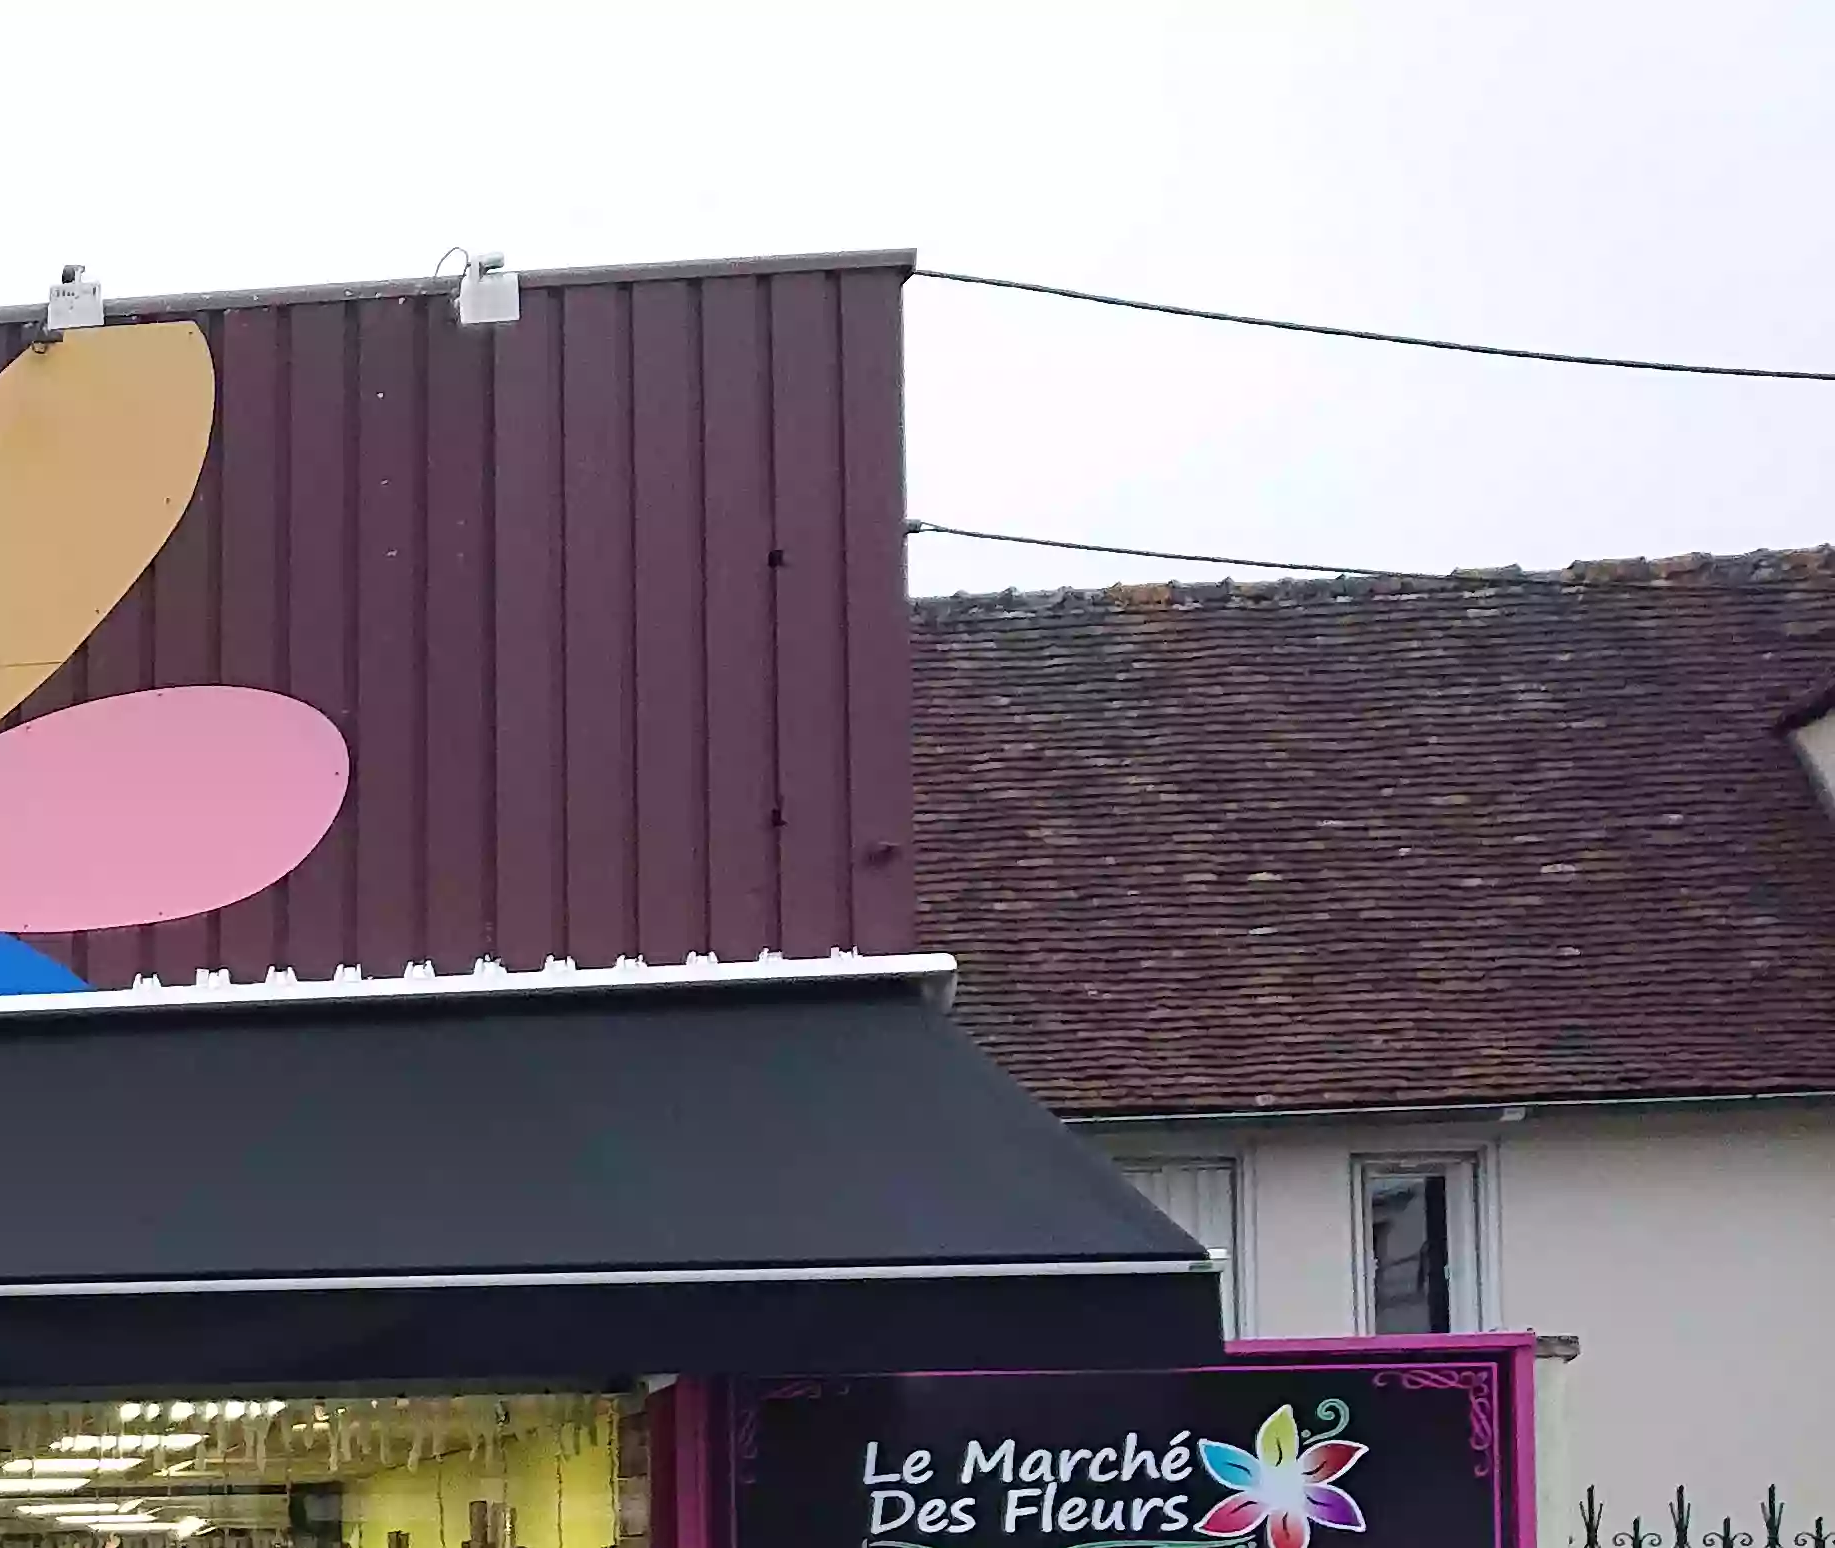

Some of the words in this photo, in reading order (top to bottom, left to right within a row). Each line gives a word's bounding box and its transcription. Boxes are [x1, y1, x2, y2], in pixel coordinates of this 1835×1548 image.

[862, 1437, 933, 1486] Le
[960, 1429, 1194, 1486] Marché
[869, 1486, 978, 1536] Des
[1002, 1480, 1192, 1534] Fleurs
